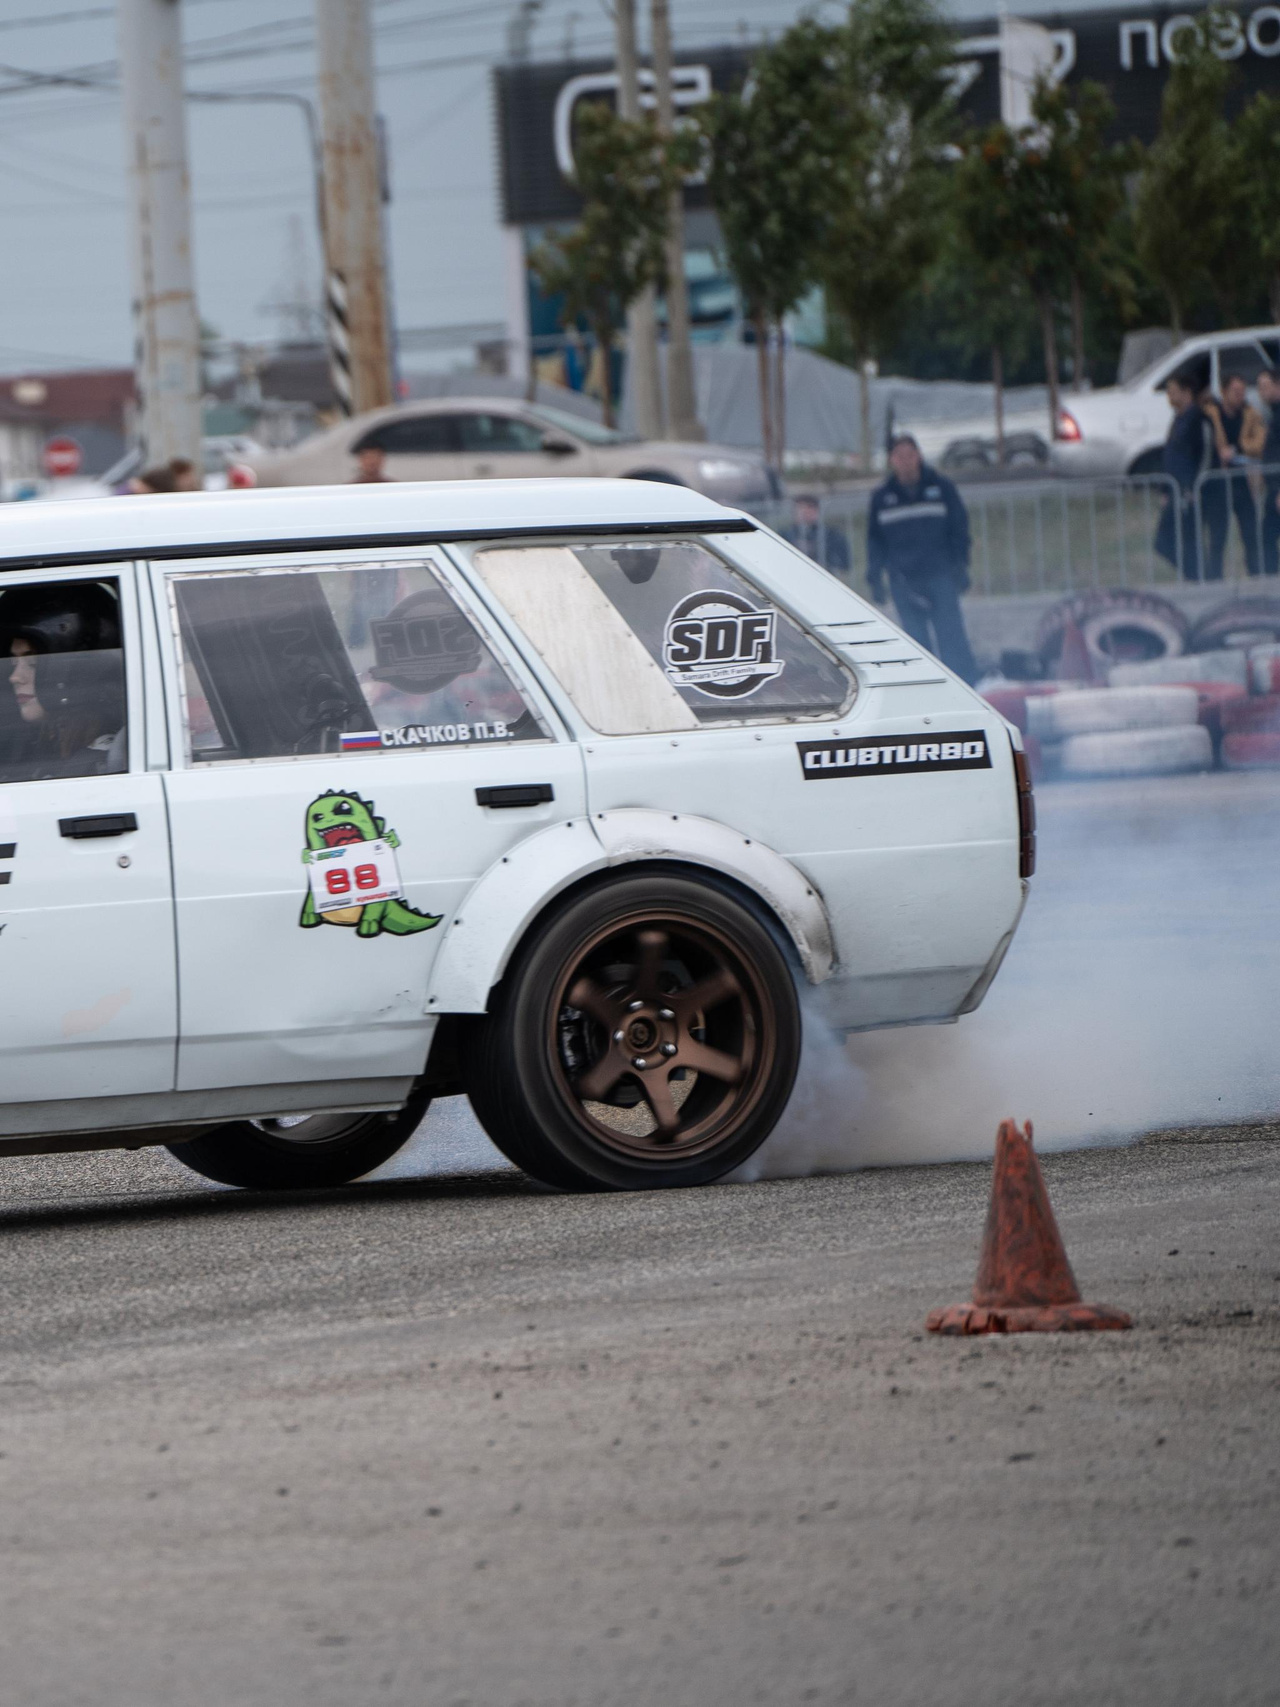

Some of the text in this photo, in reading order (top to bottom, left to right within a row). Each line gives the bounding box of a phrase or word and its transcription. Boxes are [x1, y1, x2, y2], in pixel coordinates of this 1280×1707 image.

[669, 616, 770, 663] SDF
[682, 672, 711, 681] Samara
[731, 666, 756, 675] Family
[381, 721, 514, 746] СКАЧКОВ П.В.
[805, 741, 985, 769] CLUBTURBO
[325, 864, 380, 895] 88
